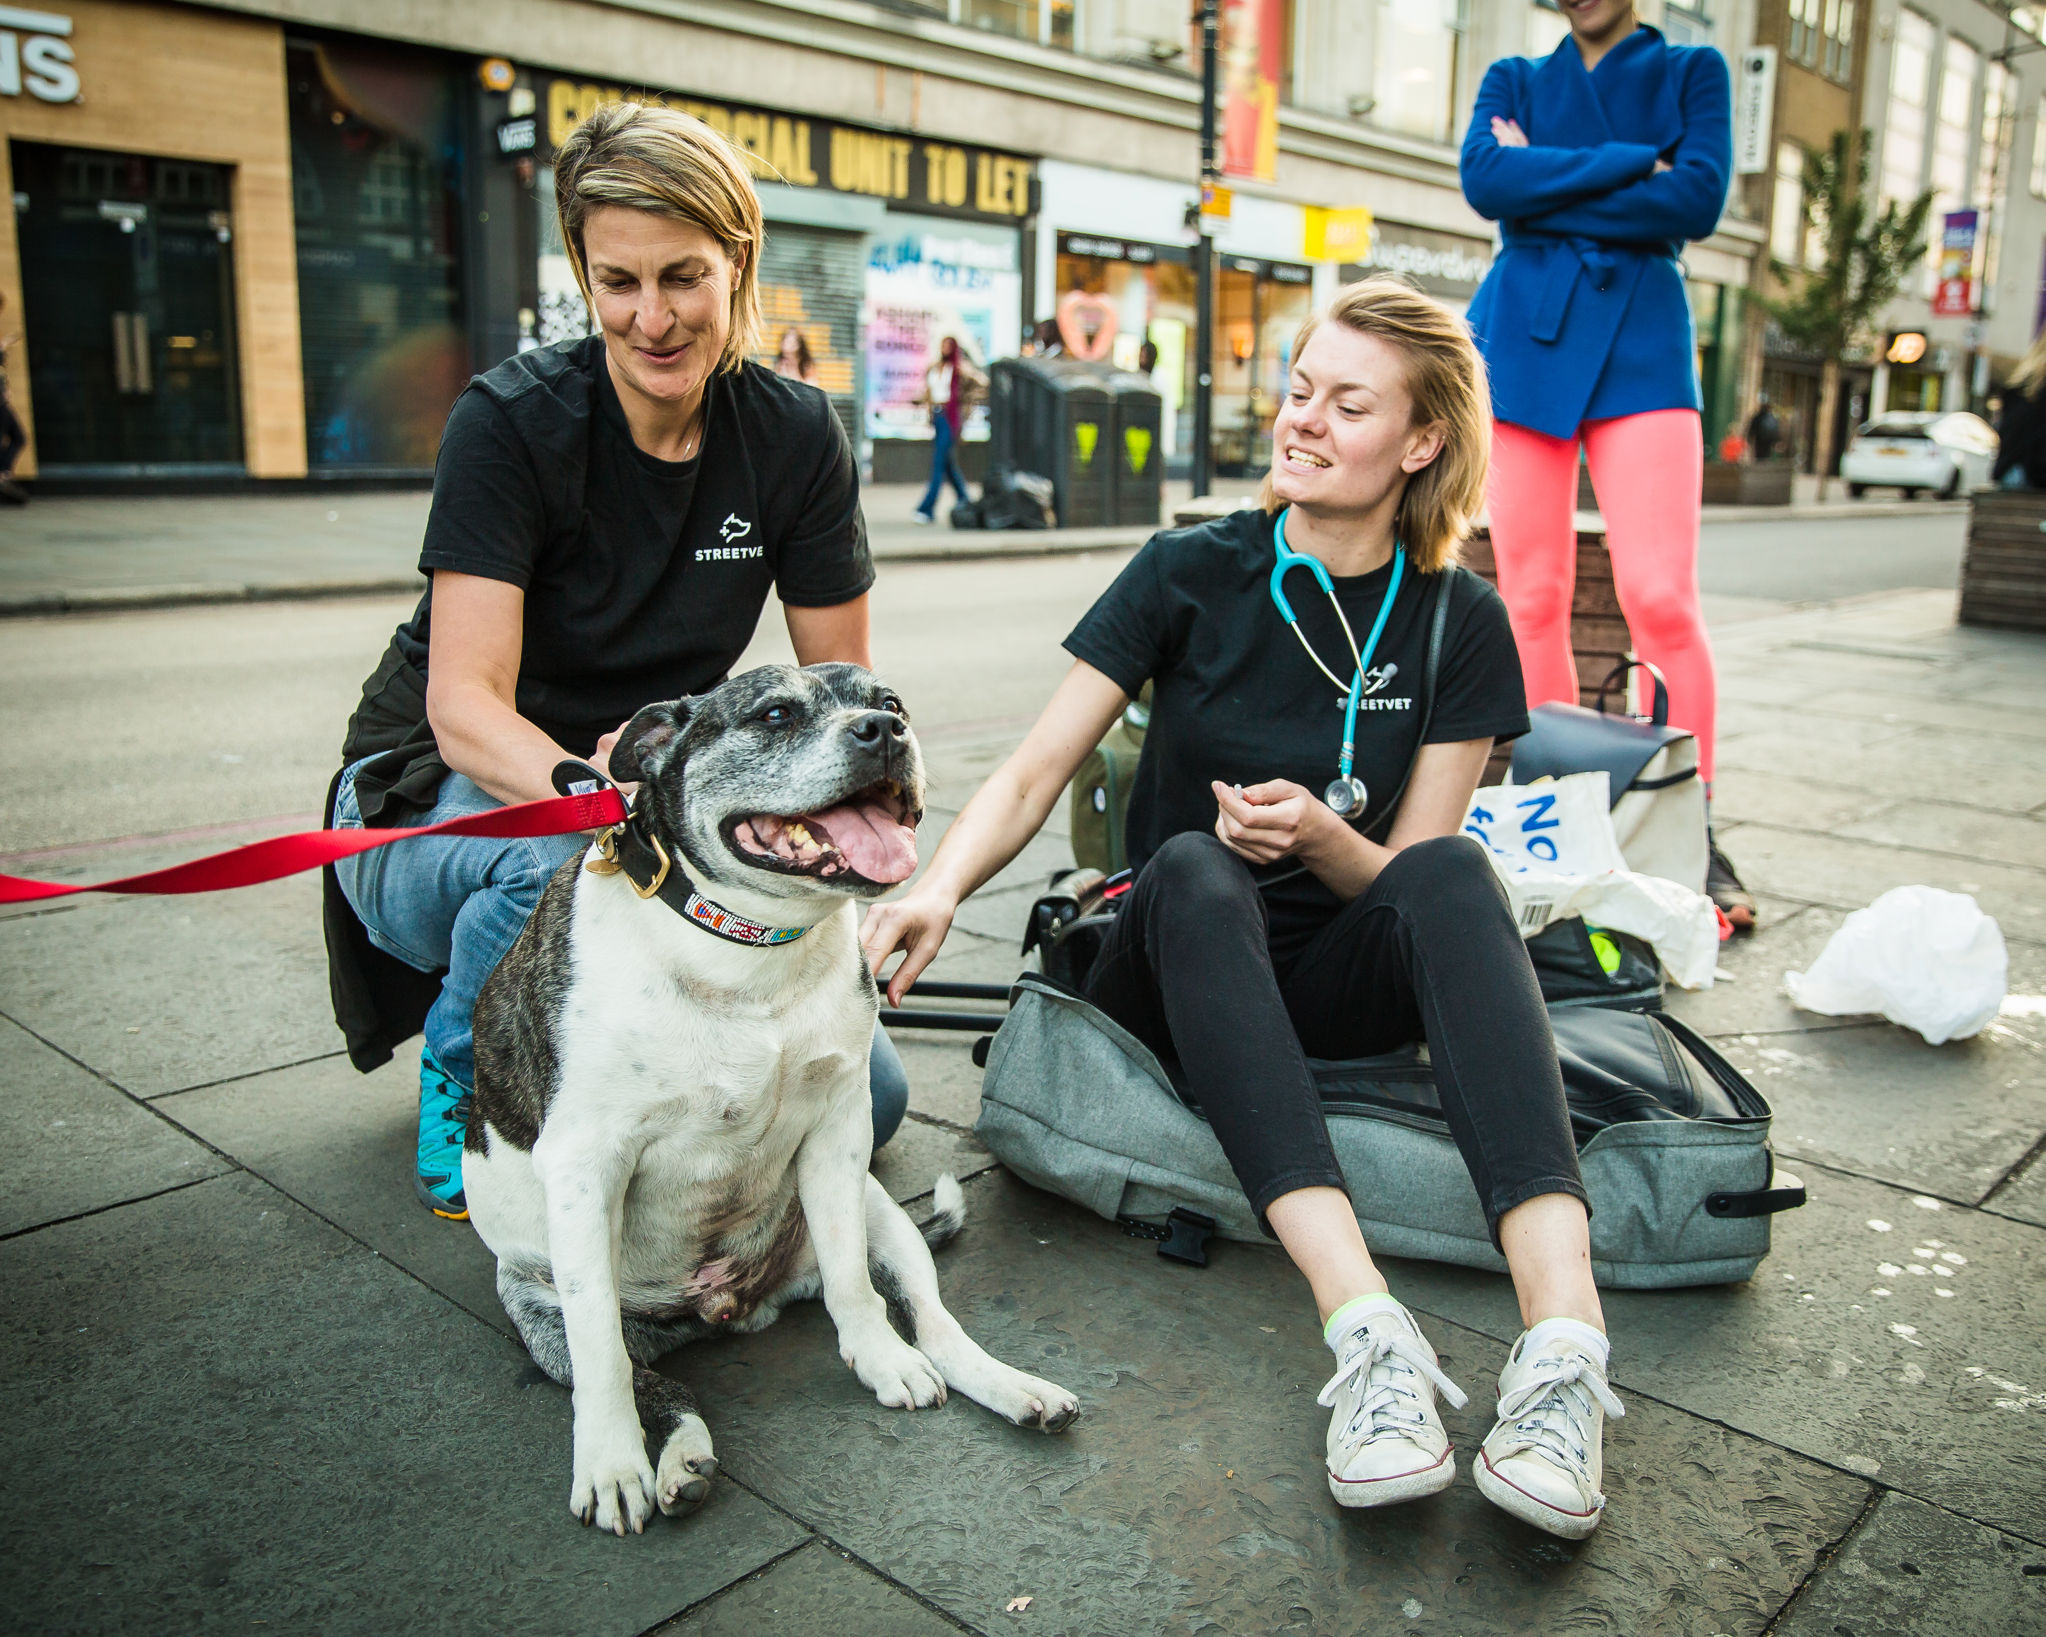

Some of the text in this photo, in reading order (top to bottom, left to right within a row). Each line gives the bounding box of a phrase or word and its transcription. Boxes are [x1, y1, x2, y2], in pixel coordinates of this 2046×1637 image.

[497, 120, 536, 152] VANS
[829, 126, 913, 199] UNIT
[924, 143, 967, 207] TO
[975, 151, 1031, 216] LET
[1336, 697, 1412, 711] SEETVET
